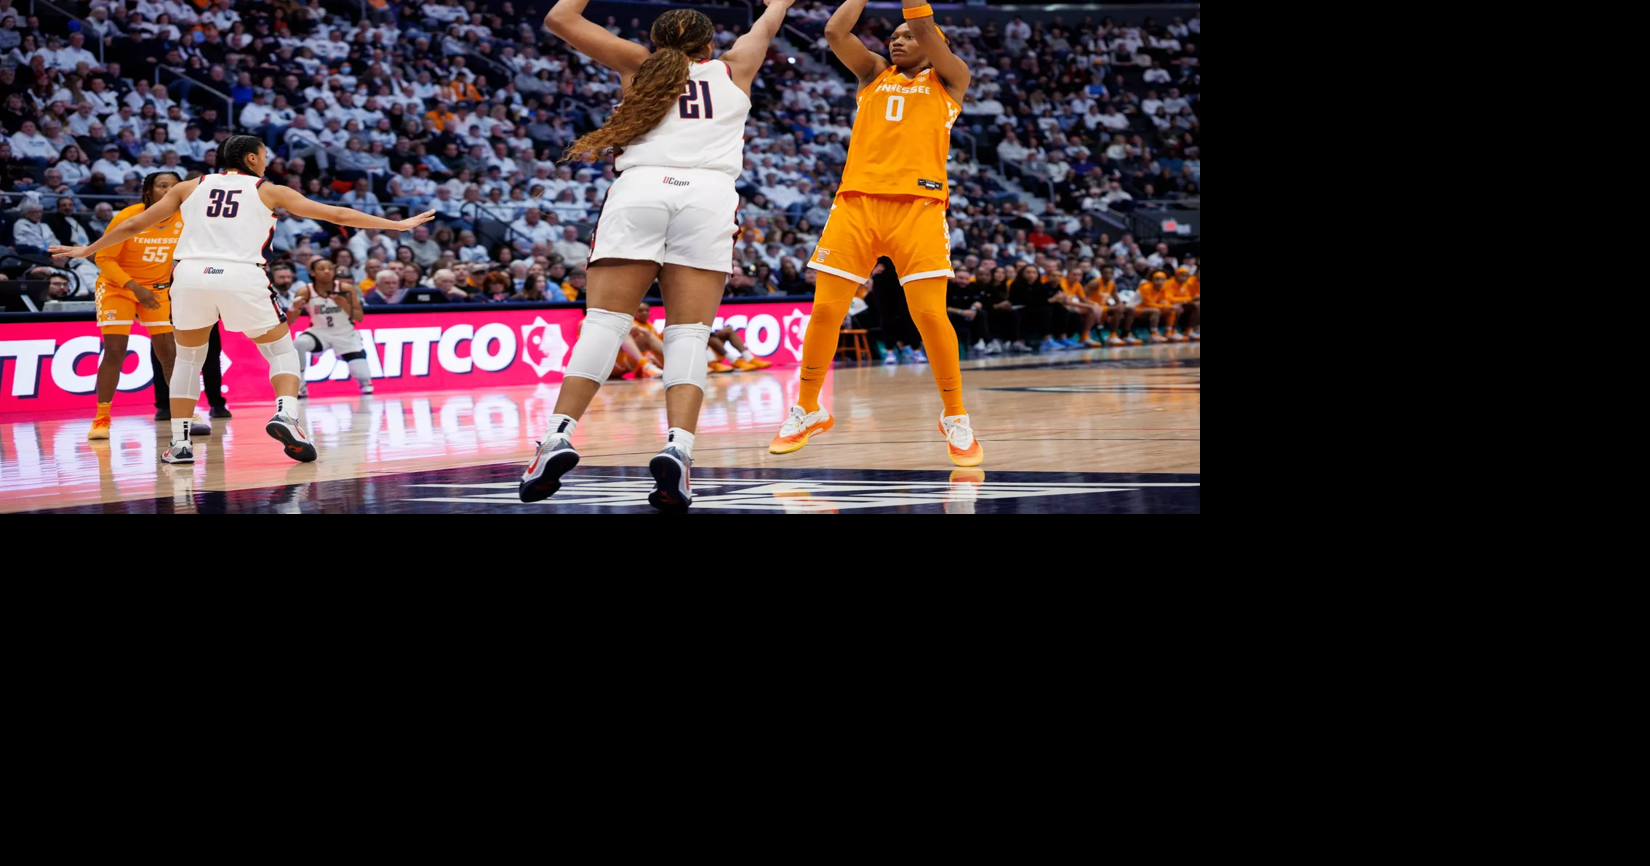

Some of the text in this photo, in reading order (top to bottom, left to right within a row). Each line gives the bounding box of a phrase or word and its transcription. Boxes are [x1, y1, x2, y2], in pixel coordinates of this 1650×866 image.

[679, 79, 713, 119] 21
[885, 95, 905, 122] 0
[662, 176, 690, 186] UConn
[206, 188, 243, 218] 35
[142, 246, 170, 263] 55
[326, 316, 334, 327] 2
